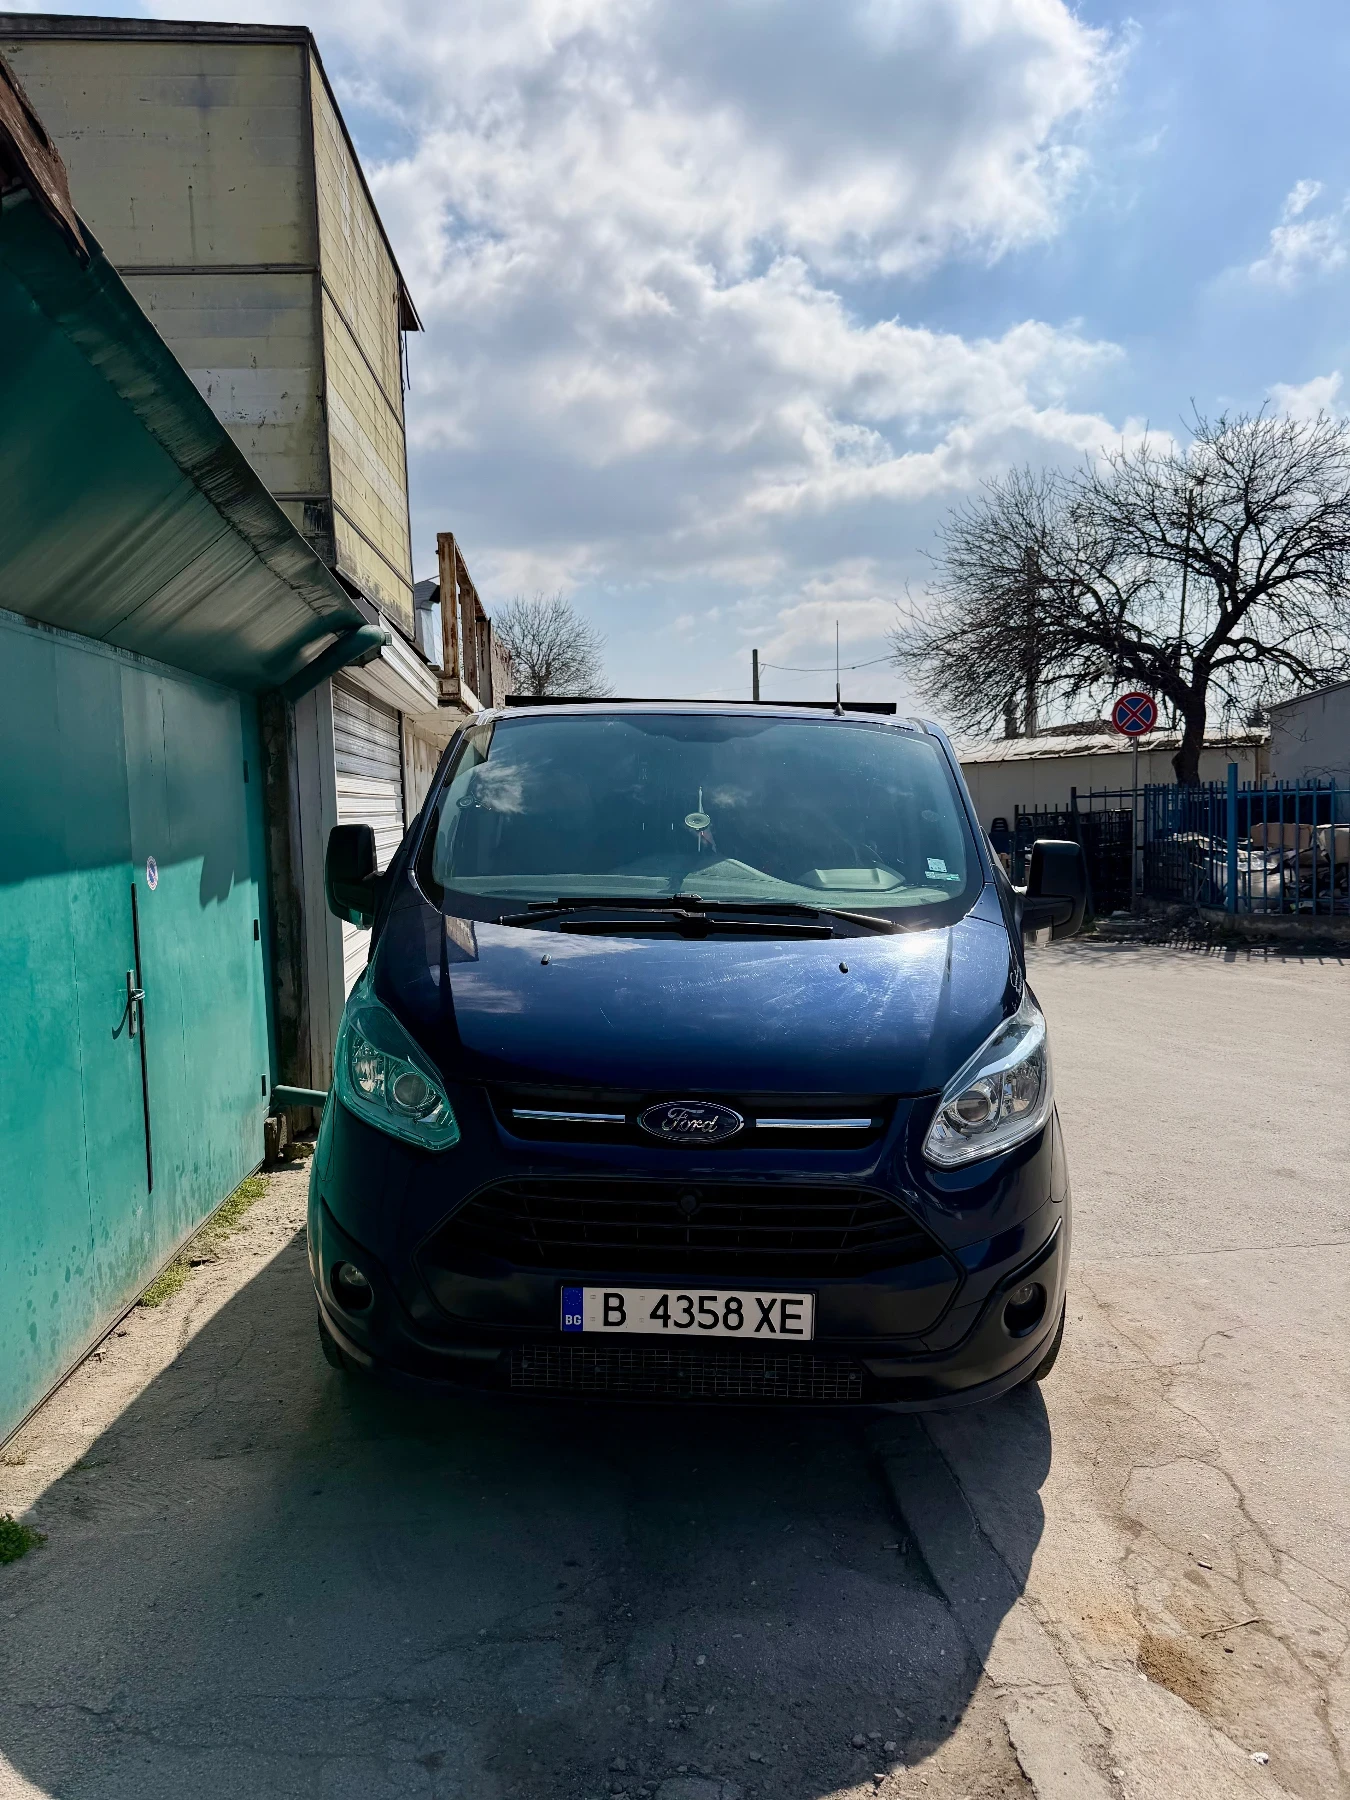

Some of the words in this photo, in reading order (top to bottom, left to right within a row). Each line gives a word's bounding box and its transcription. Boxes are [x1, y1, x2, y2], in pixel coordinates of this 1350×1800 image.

[661, 1107, 719, 1133] Ford
[565, 1314, 582, 1325] BG
[603, 1292, 627, 1327] B
[649, 1294, 744, 1331] 4358
[754, 1297, 804, 1335] XE
